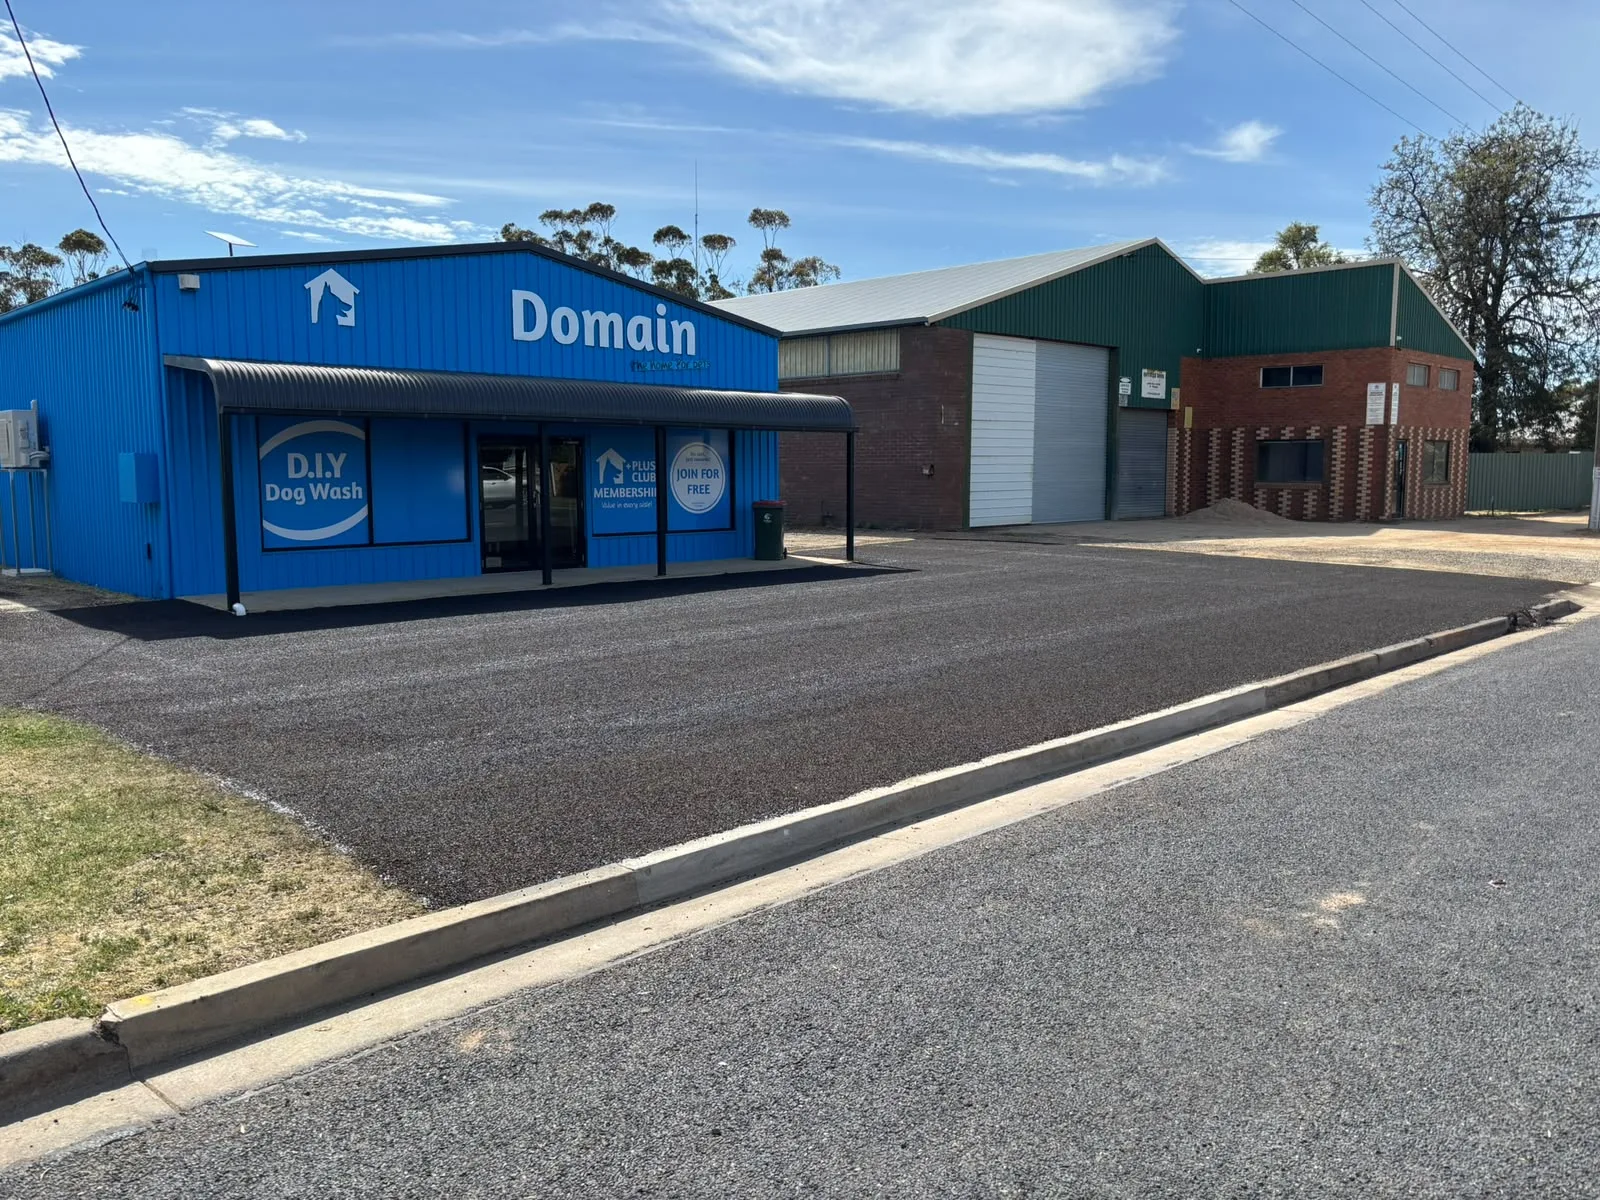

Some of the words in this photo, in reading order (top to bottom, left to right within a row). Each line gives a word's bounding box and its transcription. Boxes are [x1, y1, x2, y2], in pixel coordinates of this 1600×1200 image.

[511, 289, 697, 356] Domain
[287, 452, 348, 479] D.I.Y
[632, 472, 657, 483] CLUB
[677, 468, 698, 482] JOIN
[701, 468, 720, 479] FOR
[265, 483, 306, 506] Dog
[309, 481, 363, 500] Wash
[593, 487, 657, 498] MEMBERSHI
[687, 484, 711, 494] FREE
